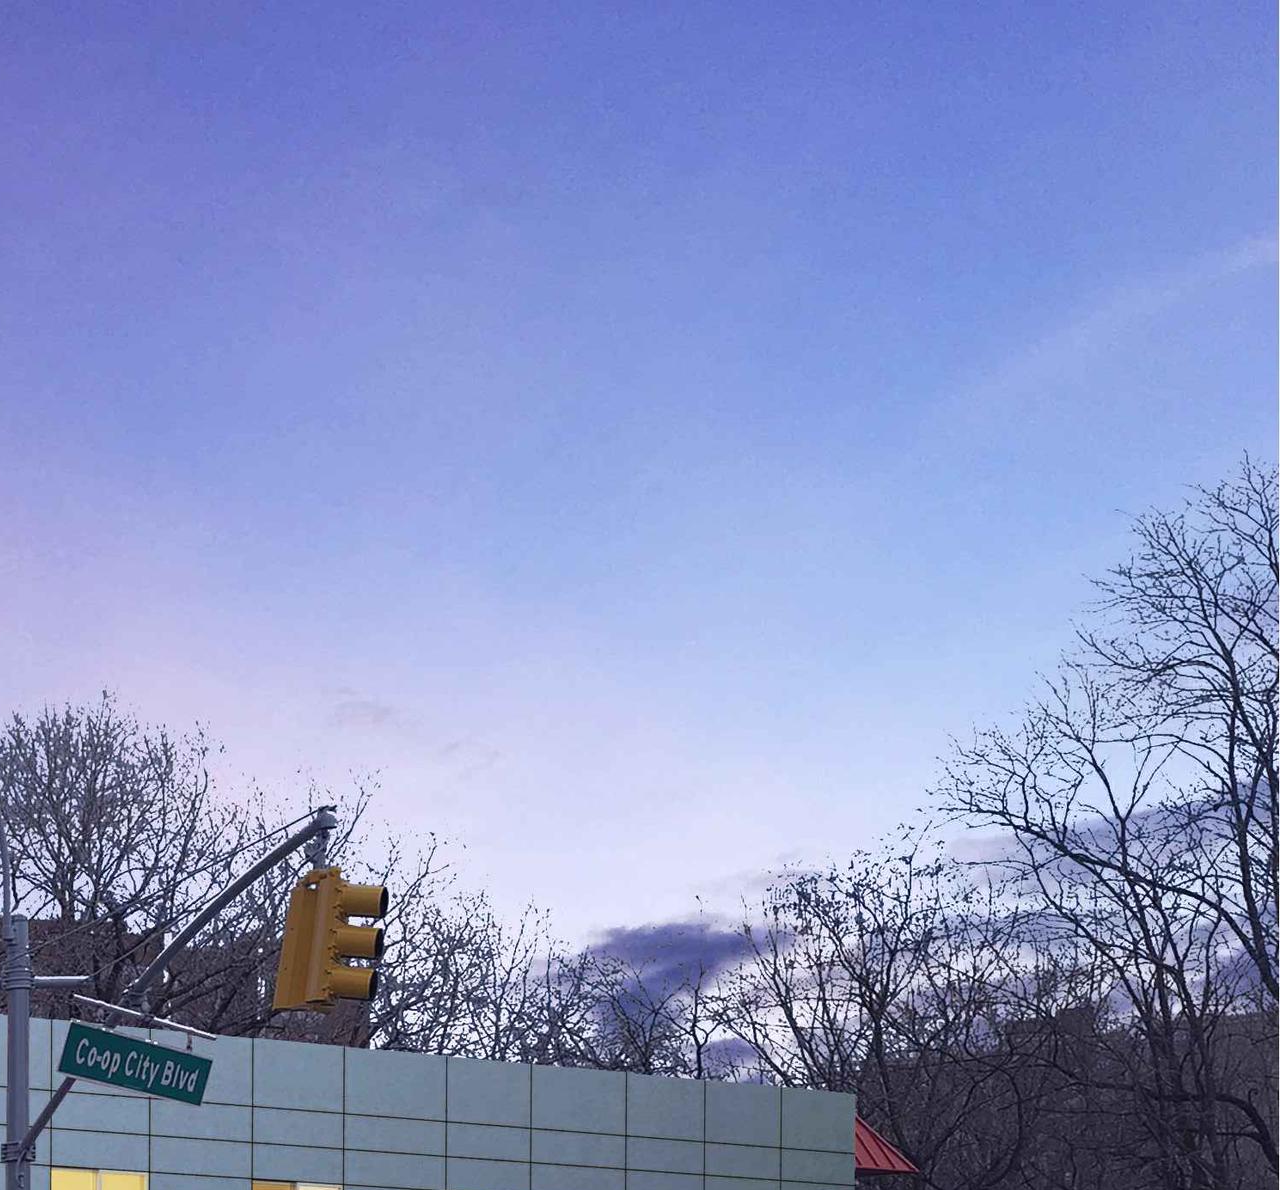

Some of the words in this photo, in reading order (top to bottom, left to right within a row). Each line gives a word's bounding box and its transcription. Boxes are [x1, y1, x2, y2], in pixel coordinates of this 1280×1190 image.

[75, 1038, 121, 1079] Co-op
[125, 1050, 160, 1089] City
[160, 1060, 200, 1093] Blvd
